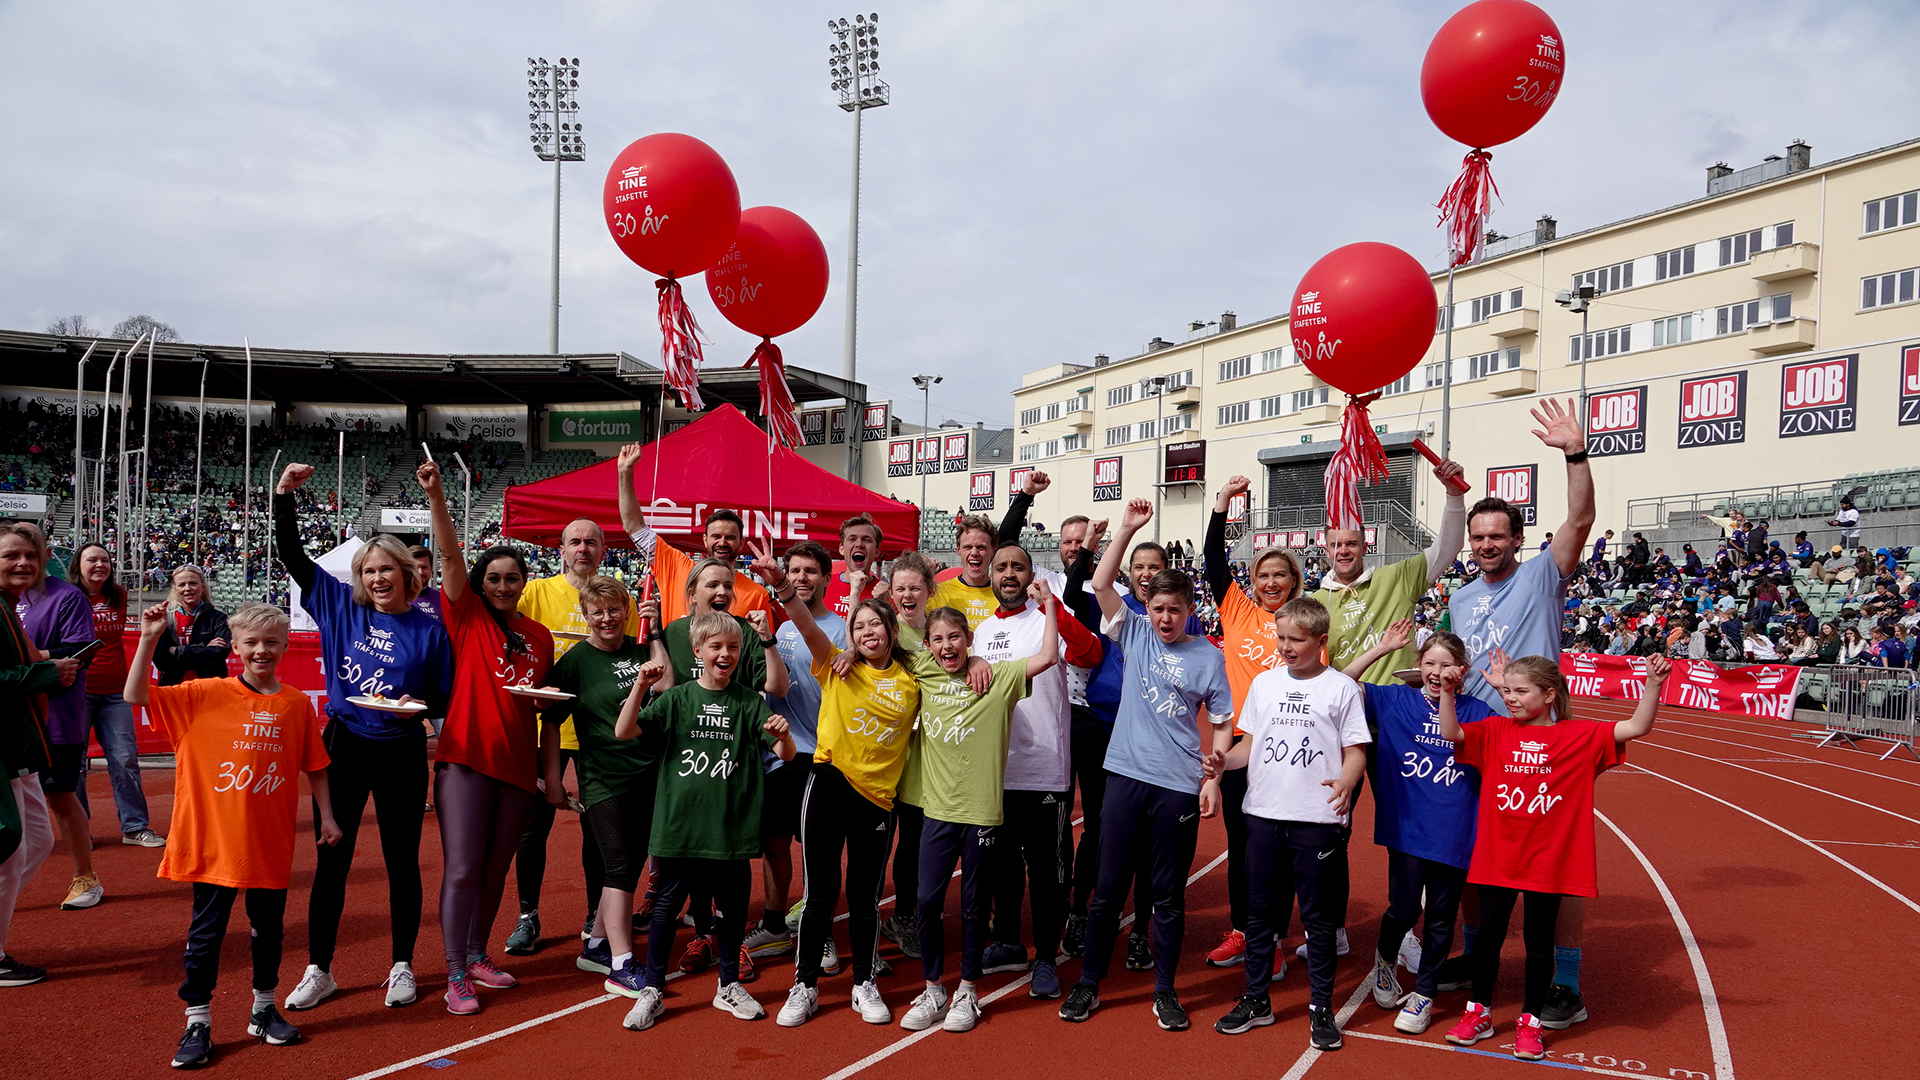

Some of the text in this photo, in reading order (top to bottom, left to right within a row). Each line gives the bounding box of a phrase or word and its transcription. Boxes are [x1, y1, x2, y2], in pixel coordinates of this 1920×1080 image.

[1536, 44, 1561, 61] TINE
[1507, 75, 1540, 101] 30
[618, 176, 648, 191] TINE
[613, 205, 669, 237] 30 år
[714, 263, 748, 277] STAFETTEN
[715, 276, 763, 307] 30 år
[1296, 302, 1322, 316] TINE
[1294, 316, 1327, 328] STAFETTEN
[1294, 331, 1342, 361] 30 år
[1787, 364, 1844, 406] JOB
[1684, 380, 1735, 419] JOB
[833, 412, 845, 430] JO
[864, 408, 884, 427] JOB
[1592, 394, 1637, 430] JOB
[1780, 407, 1854, 435] ZONE
[471, 424, 516, 438] Celsio
[577, 417, 631, 436] fortum
[802, 414, 822, 432] JOB
[862, 428, 887, 440] ZONE
[1679, 420, 1744, 446] ZONE
[946, 437, 965, 458] JOB
[1588, 432, 1644, 455] ZONE
[890, 444, 909, 463] JOB
[888, 465, 912, 476] ZONE
[944, 459, 968, 472] ZONE
[1096, 460, 1118, 484] JOB
[1174, 467, 1197, 481] 11:18
[972, 475, 991, 495] JOB
[1094, 486, 1121, 500] ZONE
[1490, 471, 1529, 501] JOB
[970, 497, 994, 510] ZONE
[1227, 495, 1245, 520] OB
[1254, 535, 1268, 548] JOB
[1290, 533, 1306, 547] JOB
[569, 612, 588, 623] TIN
[834, 603, 850, 613] TIN
[965, 607, 990, 616] TINE
[1343, 605, 1367, 621] TINE
[1363, 625, 1386, 651] år
[1485, 620, 1509, 650] år
[987, 640, 1011, 651] TINE
[1238, 638, 1264, 660] 30
[984, 652, 1013, 661] TAFETTEN
[337, 656, 393, 696] 30 år
[613, 662, 641, 679] TINE
[1149, 663, 1186, 689] STAFETTEN
[939, 683, 970, 698] TINE
[1566, 675, 1604, 696] TINE
[1620, 679, 1647, 699] TIN
[868, 692, 908, 713] STAFETTEN
[929, 694, 971, 708] STAFETTEN
[1156, 692, 1187, 718] år
[1679, 683, 1720, 711] TINE
[1740, 692, 1791, 718] TINE
[1278, 702, 1311, 715] TINE
[242, 723, 282, 738] TINE
[697, 715, 730, 728] TINE
[847, 708, 879, 736] 30
[944, 714, 975, 745] år
[1271, 717, 1315, 728] STAFETTEN
[1423, 722, 1440, 735] TI
[690, 730, 734, 741] STAFETTEN
[1414, 734, 1454, 749] STAFETTE
[232, 740, 283, 752] STAFETTEN
[1264, 736, 1324, 768] 30 år
[678, 748, 738, 780] 30 år
[1512, 751, 1549, 764] TINE
[1400, 751, 1465, 786] 30 år
[1504, 764, 1552, 774] STAFETTEN
[214, 761, 285, 796] 30 år
[1496, 782, 1563, 815] 30 år
